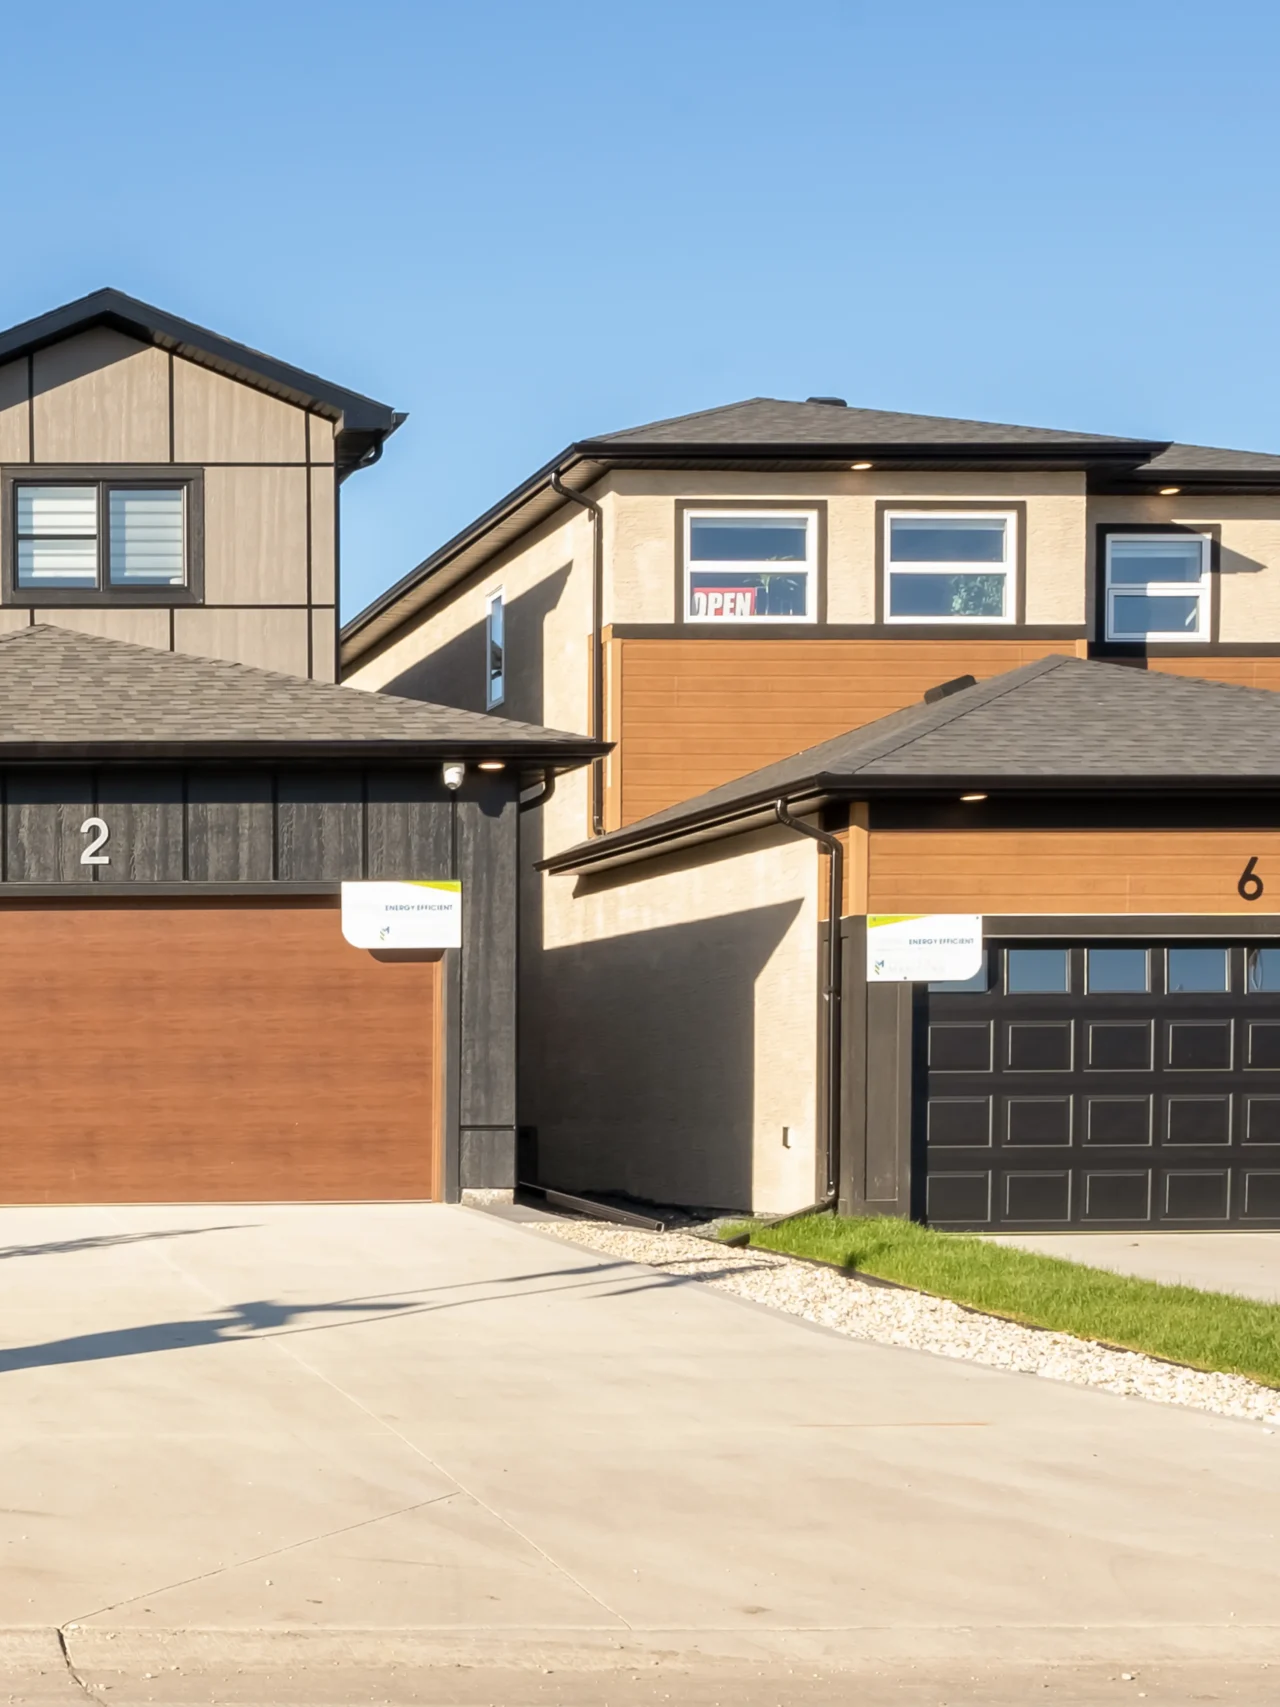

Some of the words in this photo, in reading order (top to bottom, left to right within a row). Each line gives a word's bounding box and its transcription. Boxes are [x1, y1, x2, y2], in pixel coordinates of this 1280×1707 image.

[693, 592, 751, 616] OPEN
[80, 817, 109, 865] 2
[1237, 856, 1264, 901] 6
